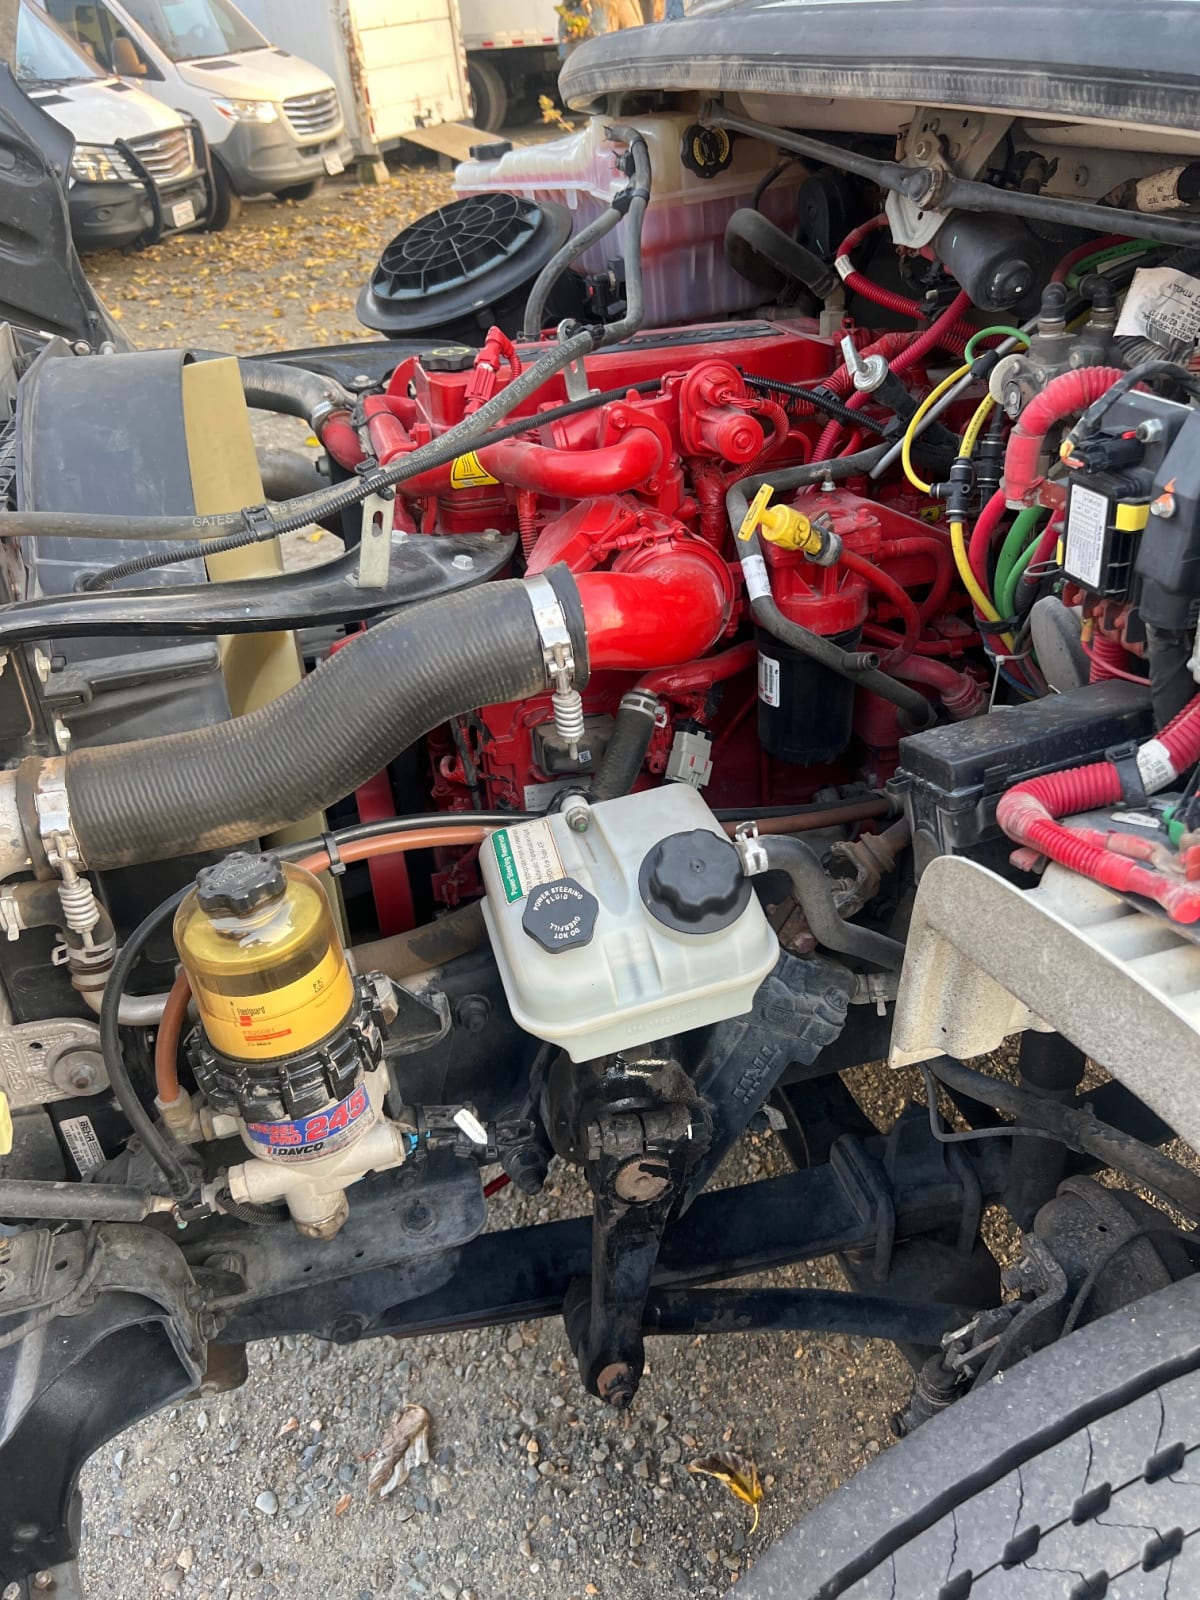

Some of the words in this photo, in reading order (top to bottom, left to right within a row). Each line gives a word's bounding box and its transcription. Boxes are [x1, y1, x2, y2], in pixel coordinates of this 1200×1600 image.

[192, 514, 234, 527] GATES
[498, 834, 508, 857] Reservoir
[503, 856, 514, 879] Steering
[508, 877, 518, 896] Power
[533, 891, 550, 911] POWER
[551, 886, 583, 900] STEERING
[545, 894, 569, 905] FLUID
[549, 916, 581, 932] OVERFILL
[553, 932, 569, 940] NOT
[570, 927, 581, 938] DO
[247, 1122, 300, 1136] DIESEL
[305, 1087, 367, 1142] 245
[80, 1120, 95, 1143] BEHR
[269, 1133, 302, 1145] PRO
[277, 1142, 324, 1156] DAVCO
